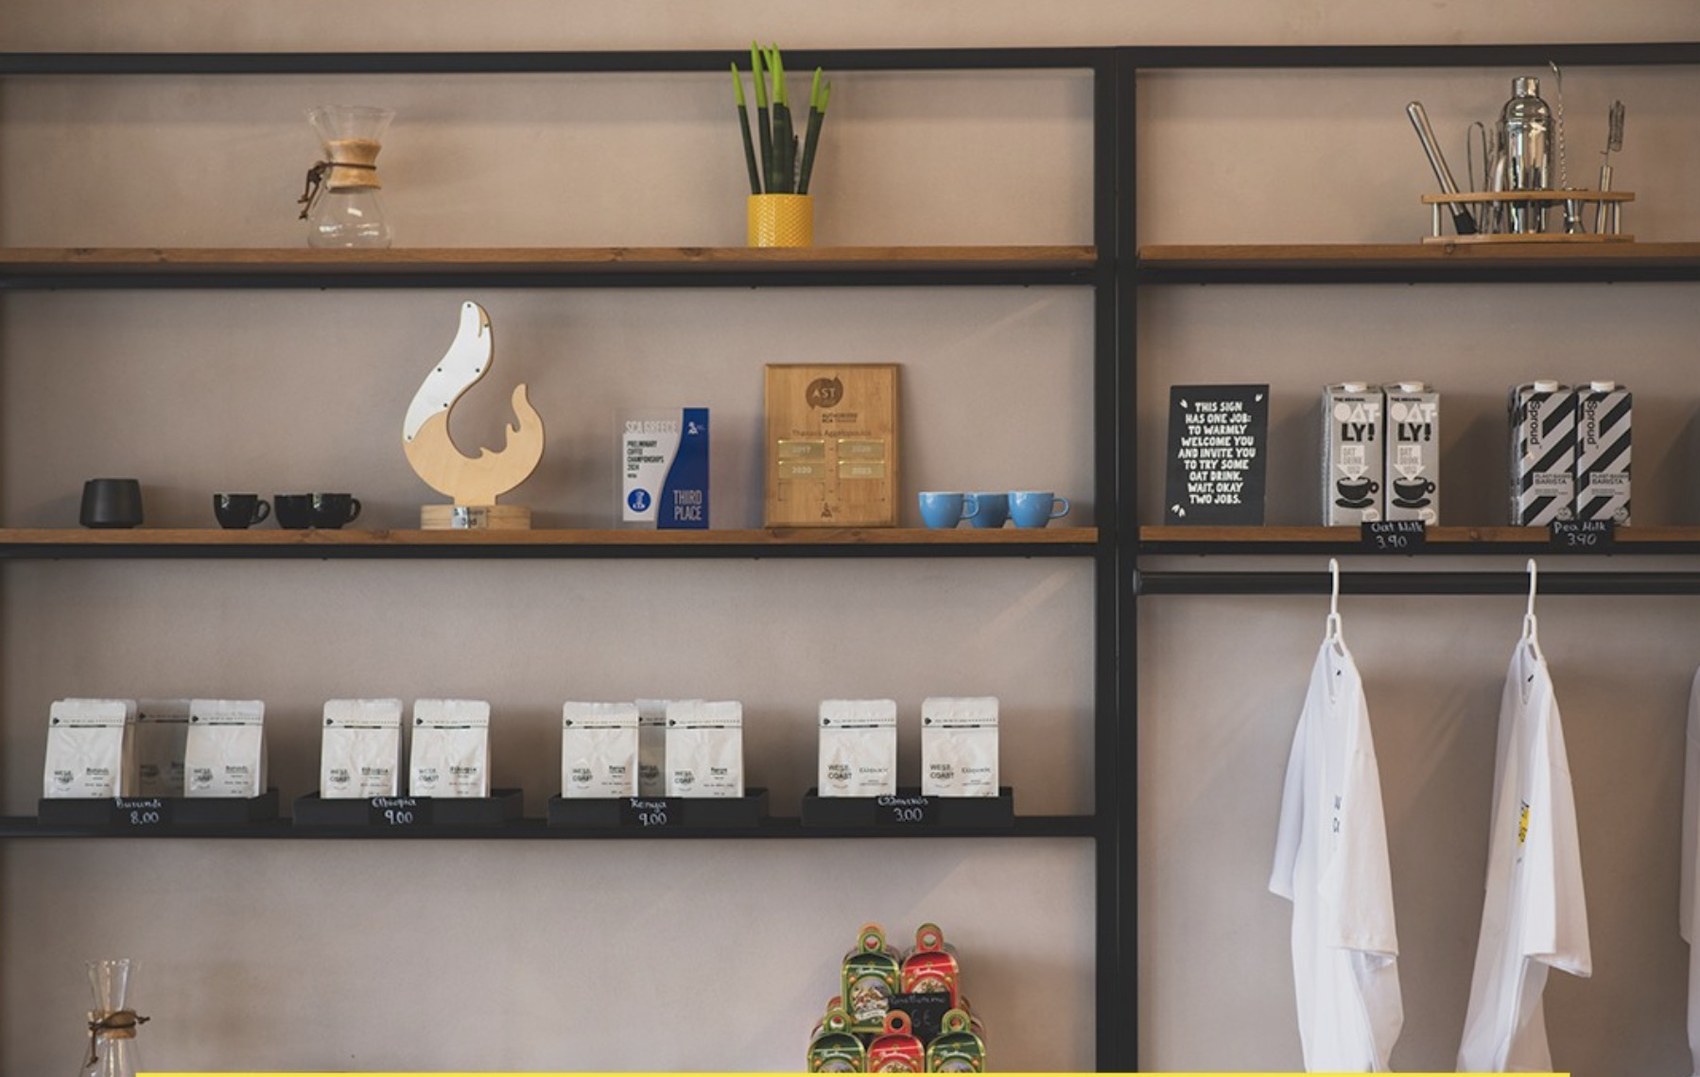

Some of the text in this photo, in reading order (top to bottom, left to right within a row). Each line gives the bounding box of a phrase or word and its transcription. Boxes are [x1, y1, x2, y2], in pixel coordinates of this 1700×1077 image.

[812, 388, 835, 398] AST
[1195, 402, 1242, 412] THIS SIGN
[1185, 414, 1251, 423] HAS ONE JOB:
[1528, 401, 1541, 445] Sproud
[1585, 401, 1597, 445] Sproud
[1188, 425, 1247, 435] TO WARMLY
[1342, 423, 1374, 441] LY!
[1398, 423, 1431, 441] LY!
[1181, 437, 1253, 446] WELCOME YOU
[1178, 448, 1256, 458] AND INVITE YOU
[1184, 460, 1249, 470] TO TRY SOME
[1189, 471, 1242, 481] OAT DRINK.
[1187, 482, 1244, 493] WAIT, OKAY
[673, 490, 702, 504] THIRD
[1189, 494, 1241, 504] TWO JOBS.
[675, 506, 702, 520] PLACE
[1554, 522, 1606, 533] Pea Milk
[630, 798, 667, 813] Kenya
[130, 812, 159, 825] 8.00
